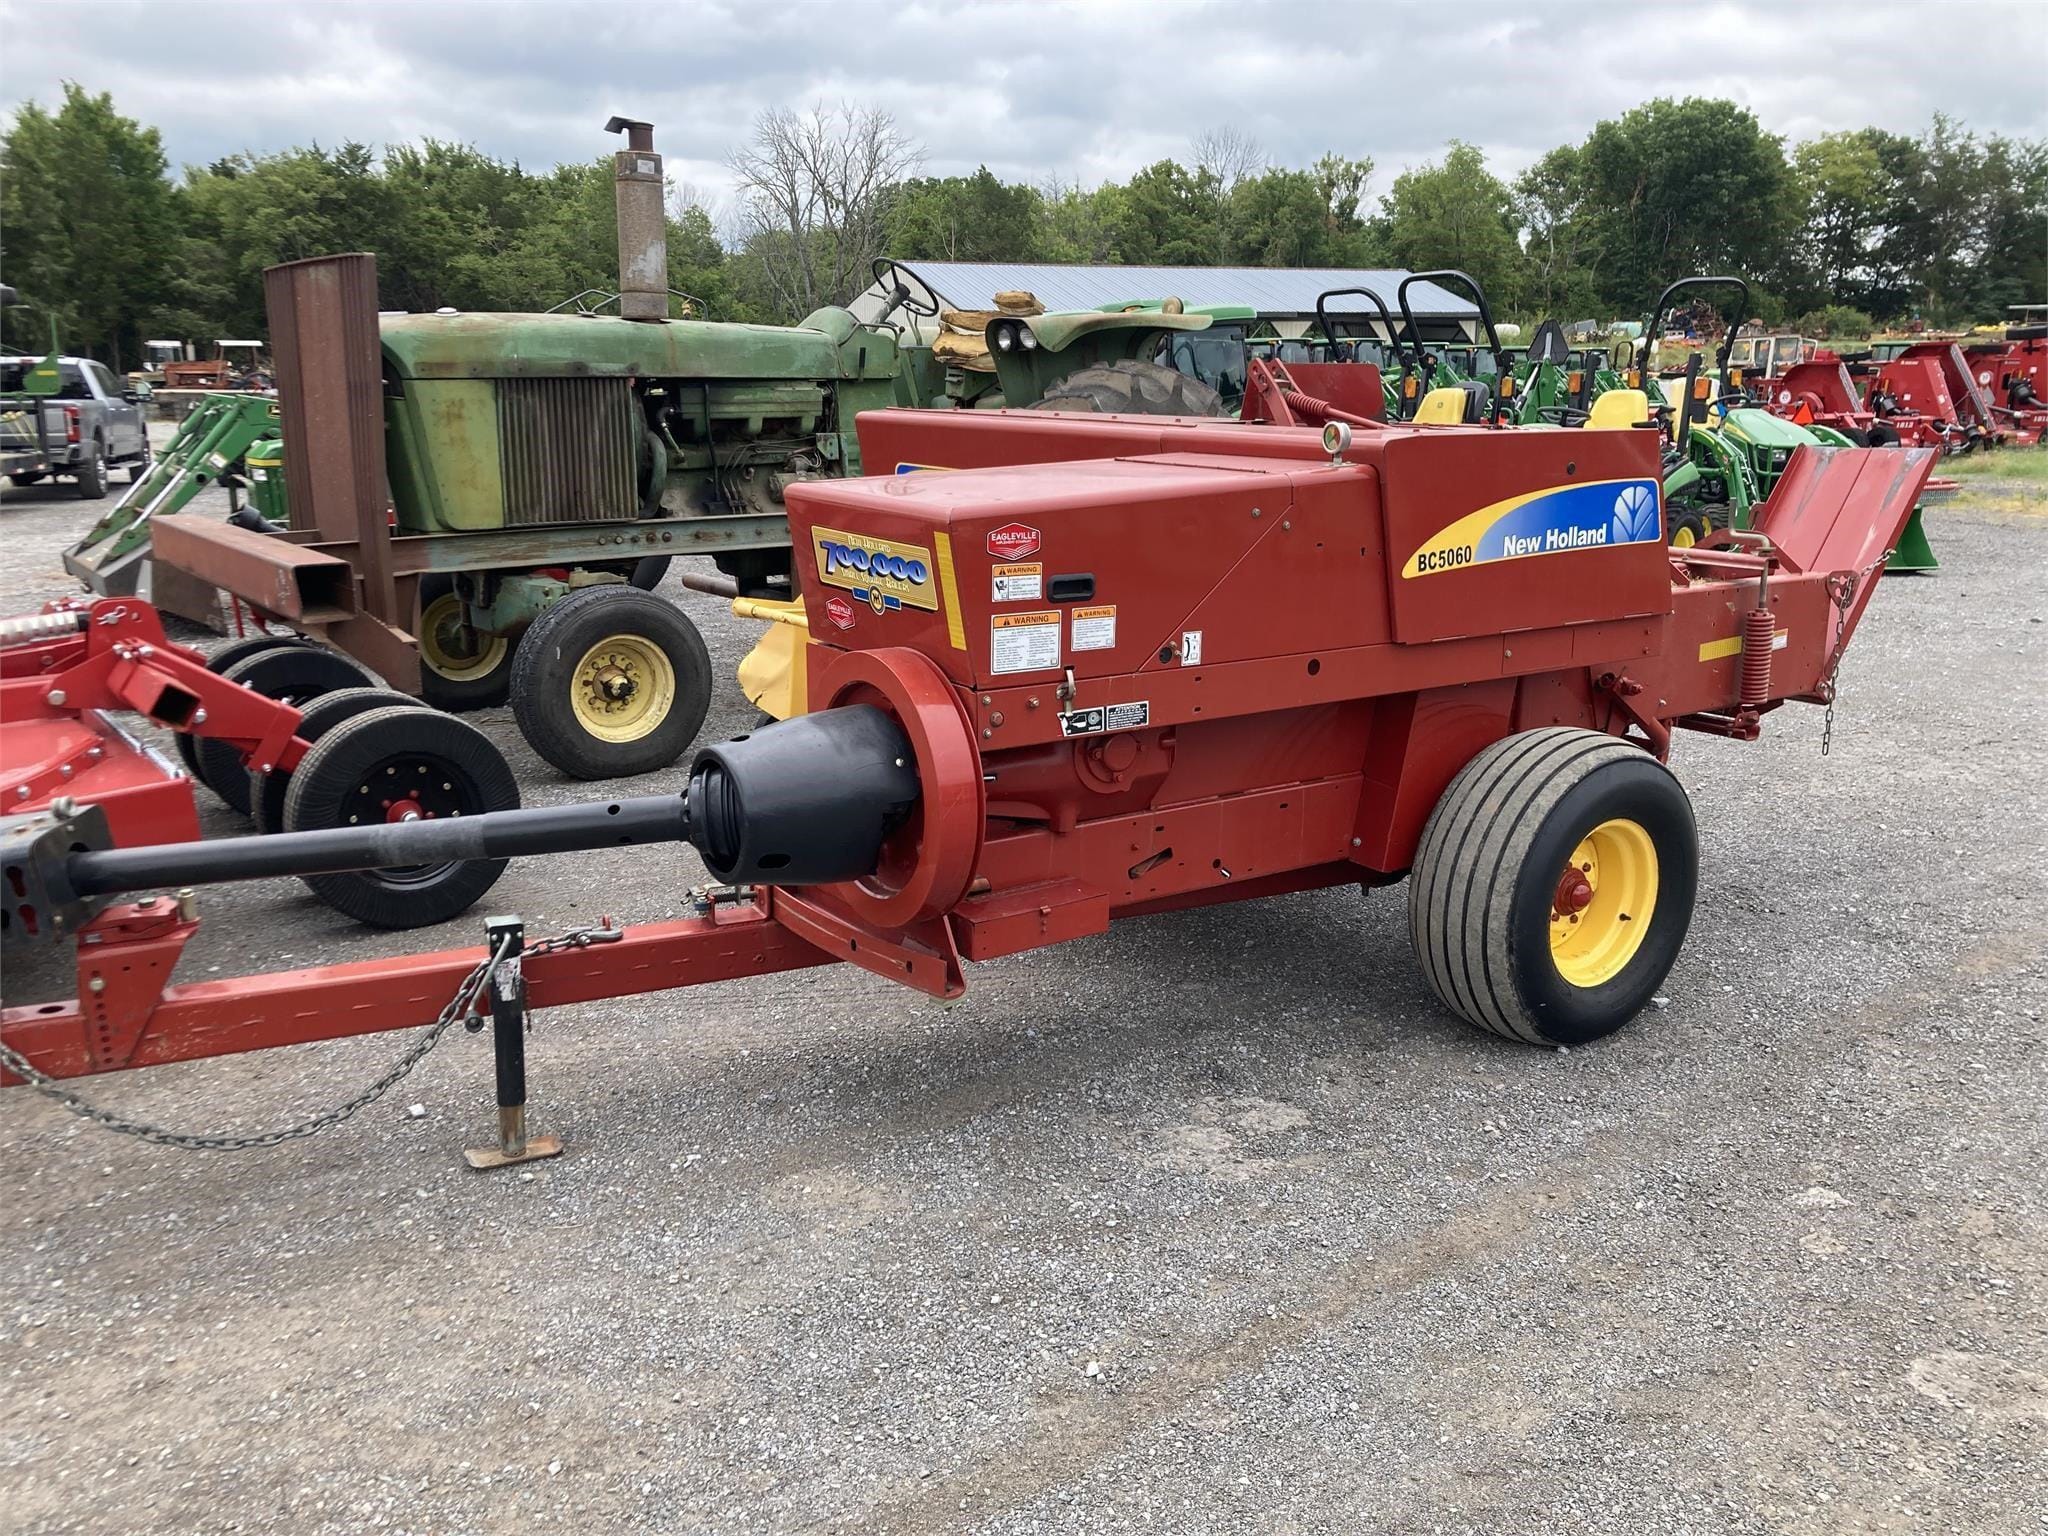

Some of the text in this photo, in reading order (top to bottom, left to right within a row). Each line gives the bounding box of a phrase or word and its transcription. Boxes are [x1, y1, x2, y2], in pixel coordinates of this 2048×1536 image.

[991, 531, 1037, 541] EAGLEVILLE
[1503, 523, 1607, 557] New Holland
[819, 540, 927, 585] 700,000
[1417, 545, 1472, 573] BC5060
[1007, 566, 1038, 574] WARNING
[828, 602, 850, 614] EAGLEVILLE
[1084, 609, 1111, 617] WARNING
[1013, 614, 1049, 625] WARNING
